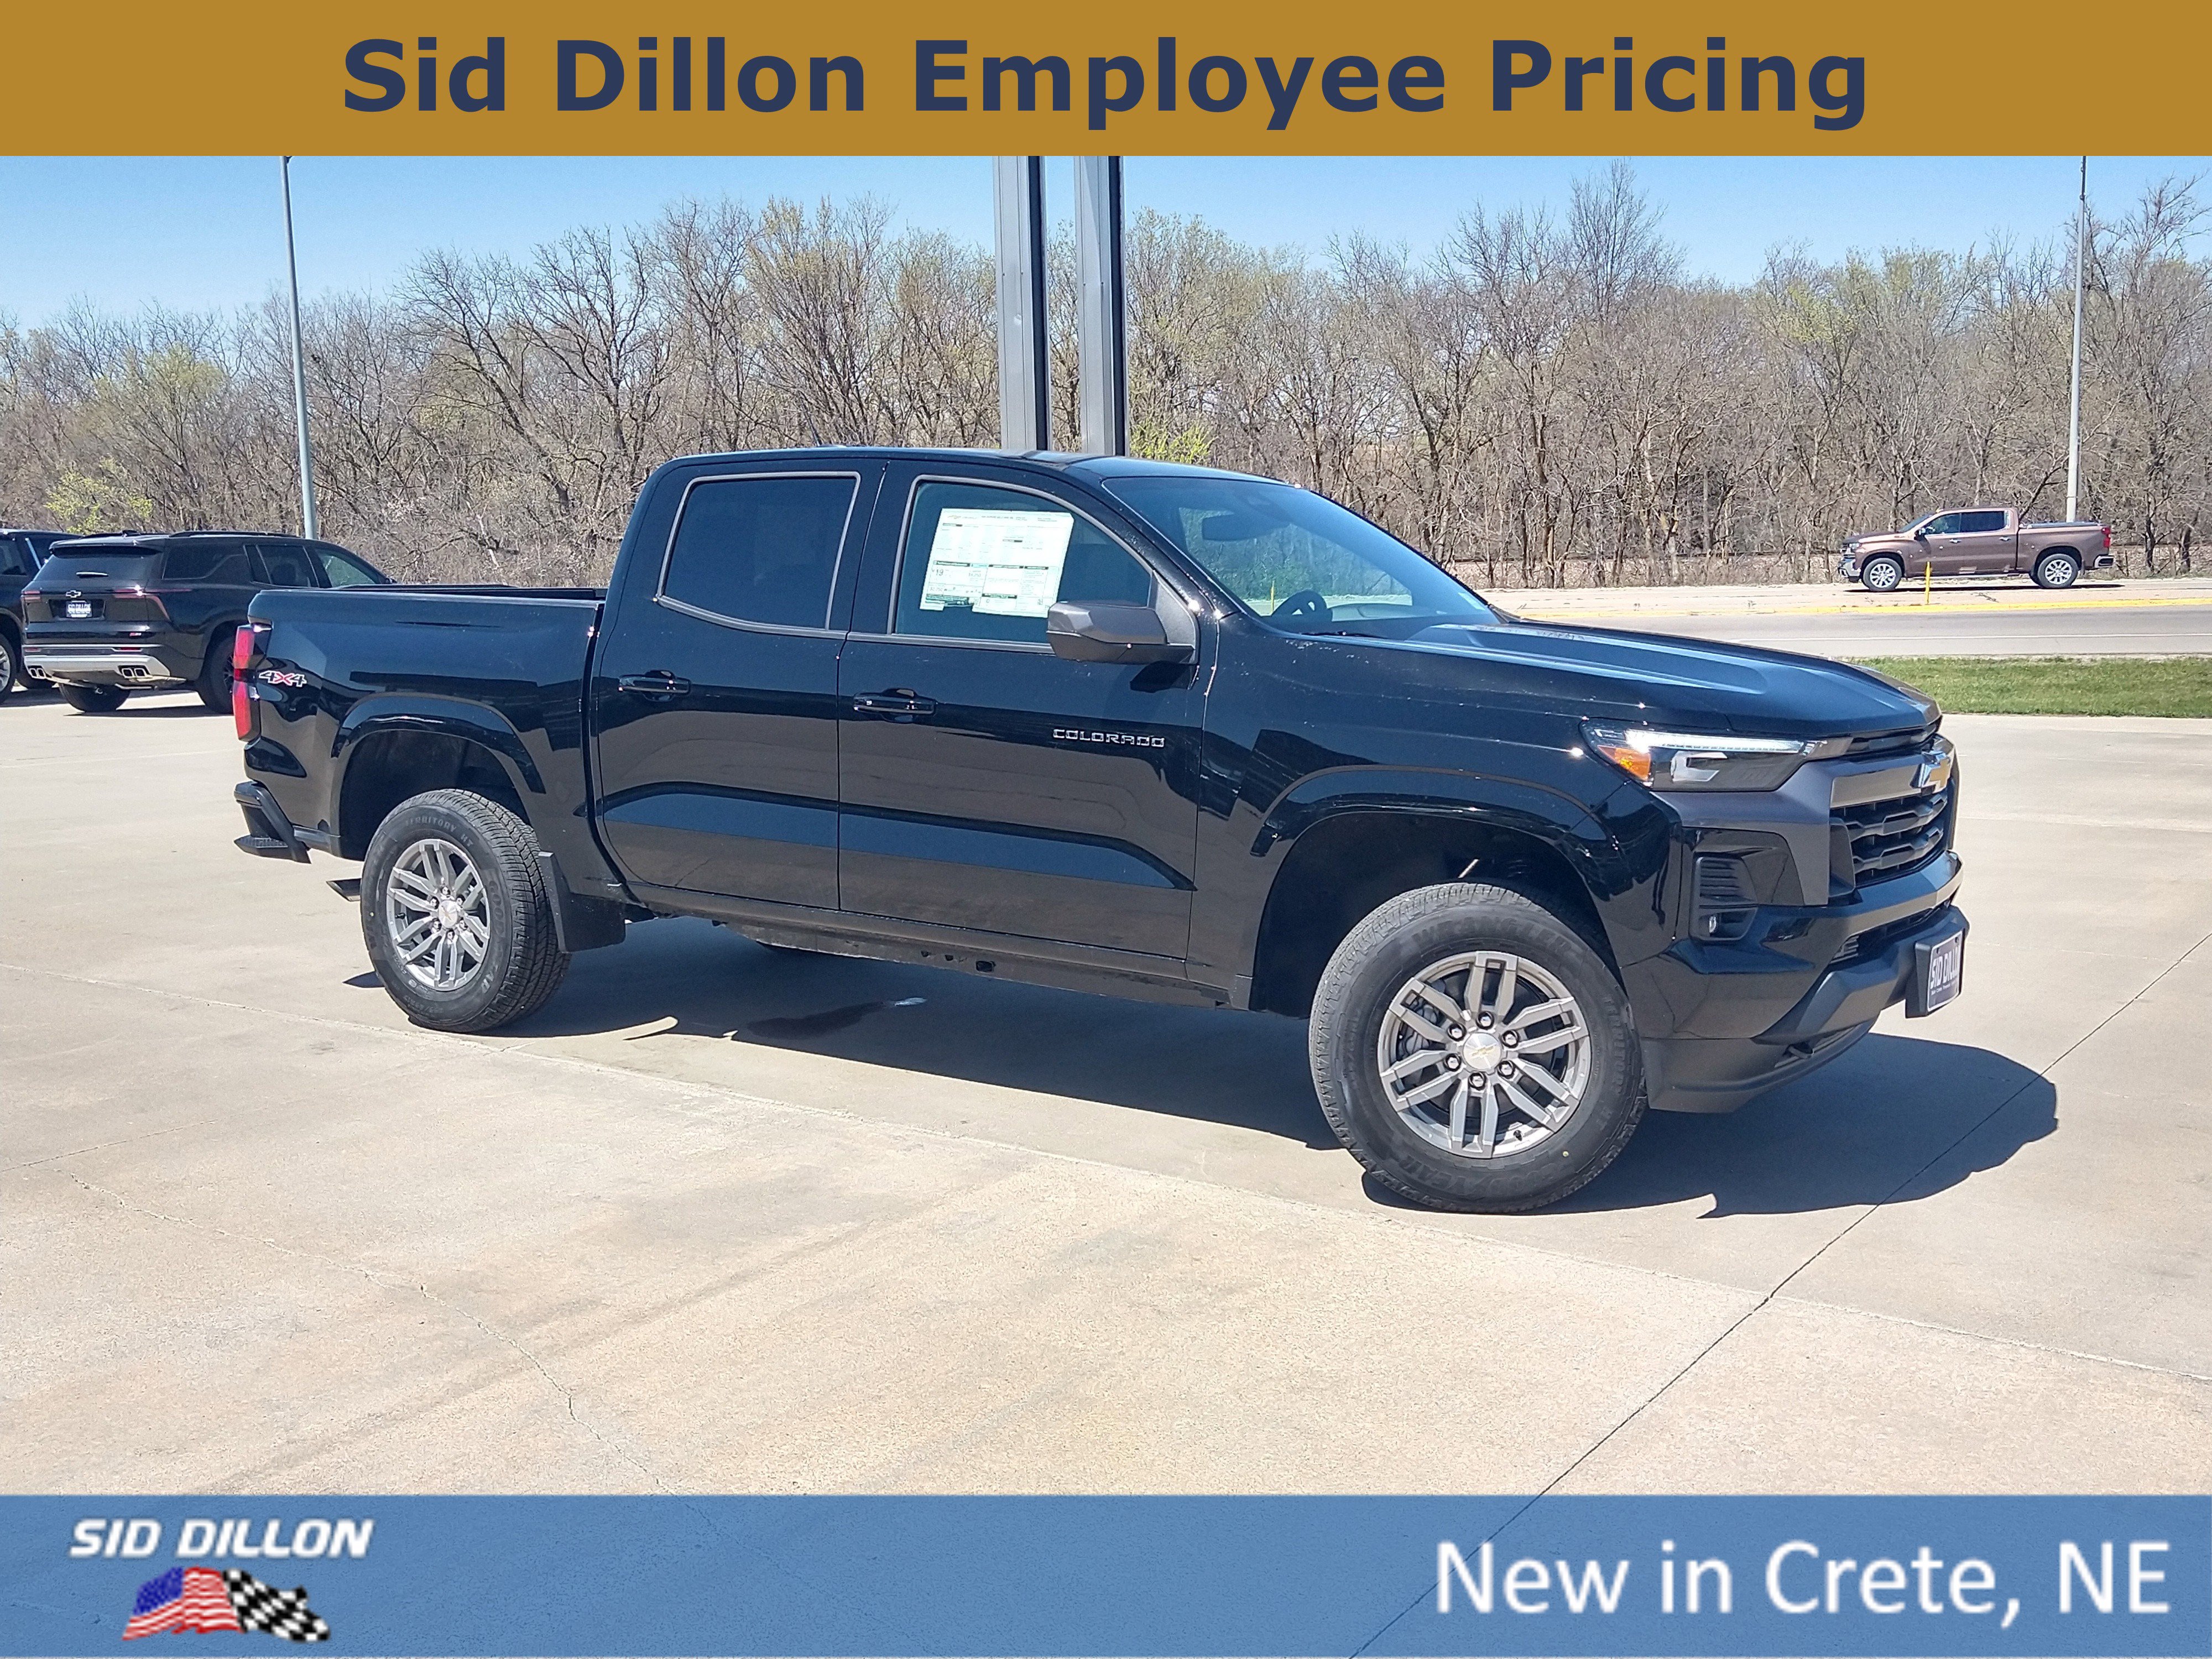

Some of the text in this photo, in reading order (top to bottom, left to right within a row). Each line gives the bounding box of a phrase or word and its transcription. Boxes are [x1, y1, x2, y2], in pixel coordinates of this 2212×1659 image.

[1052, 728, 1165, 748] COLORADO
[1930, 955, 1943, 990] SID
[1942, 946, 1959, 984] DILLO
